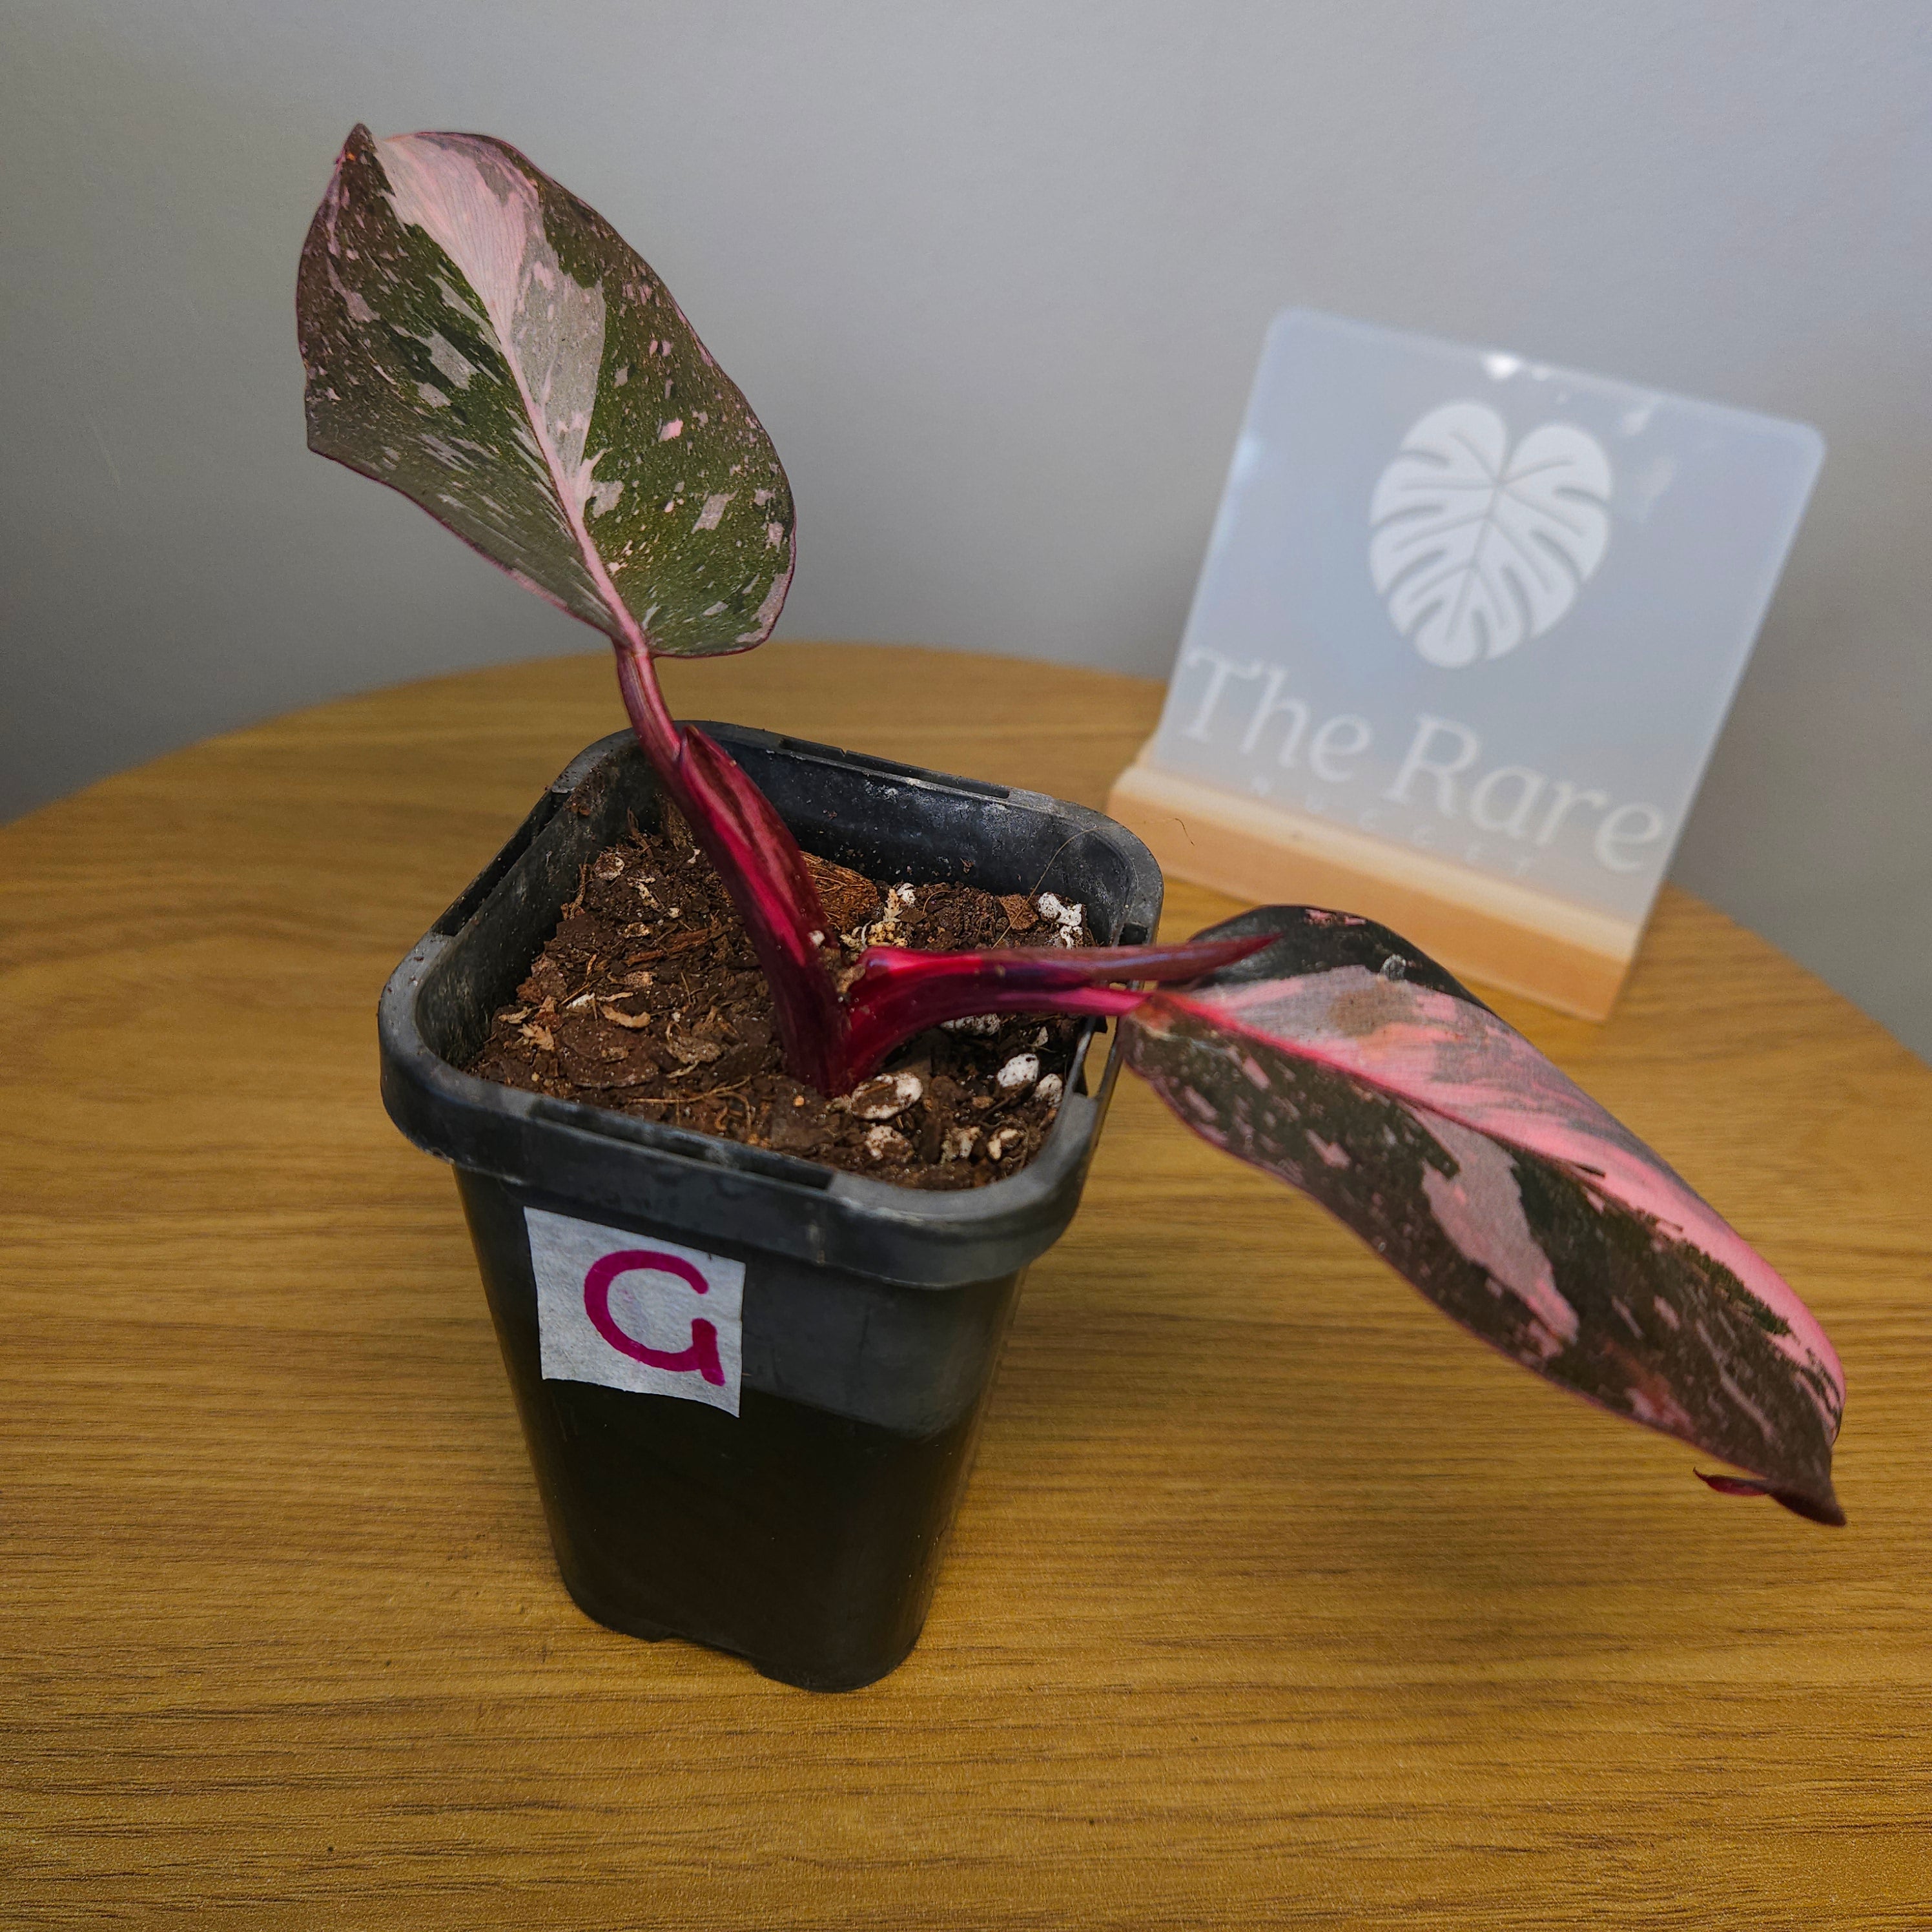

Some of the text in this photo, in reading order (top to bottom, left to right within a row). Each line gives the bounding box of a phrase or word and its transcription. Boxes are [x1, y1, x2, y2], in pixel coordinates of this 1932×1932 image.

[1184, 648, 1663, 874] The Rare
[584, 1249, 726, 1387] G
